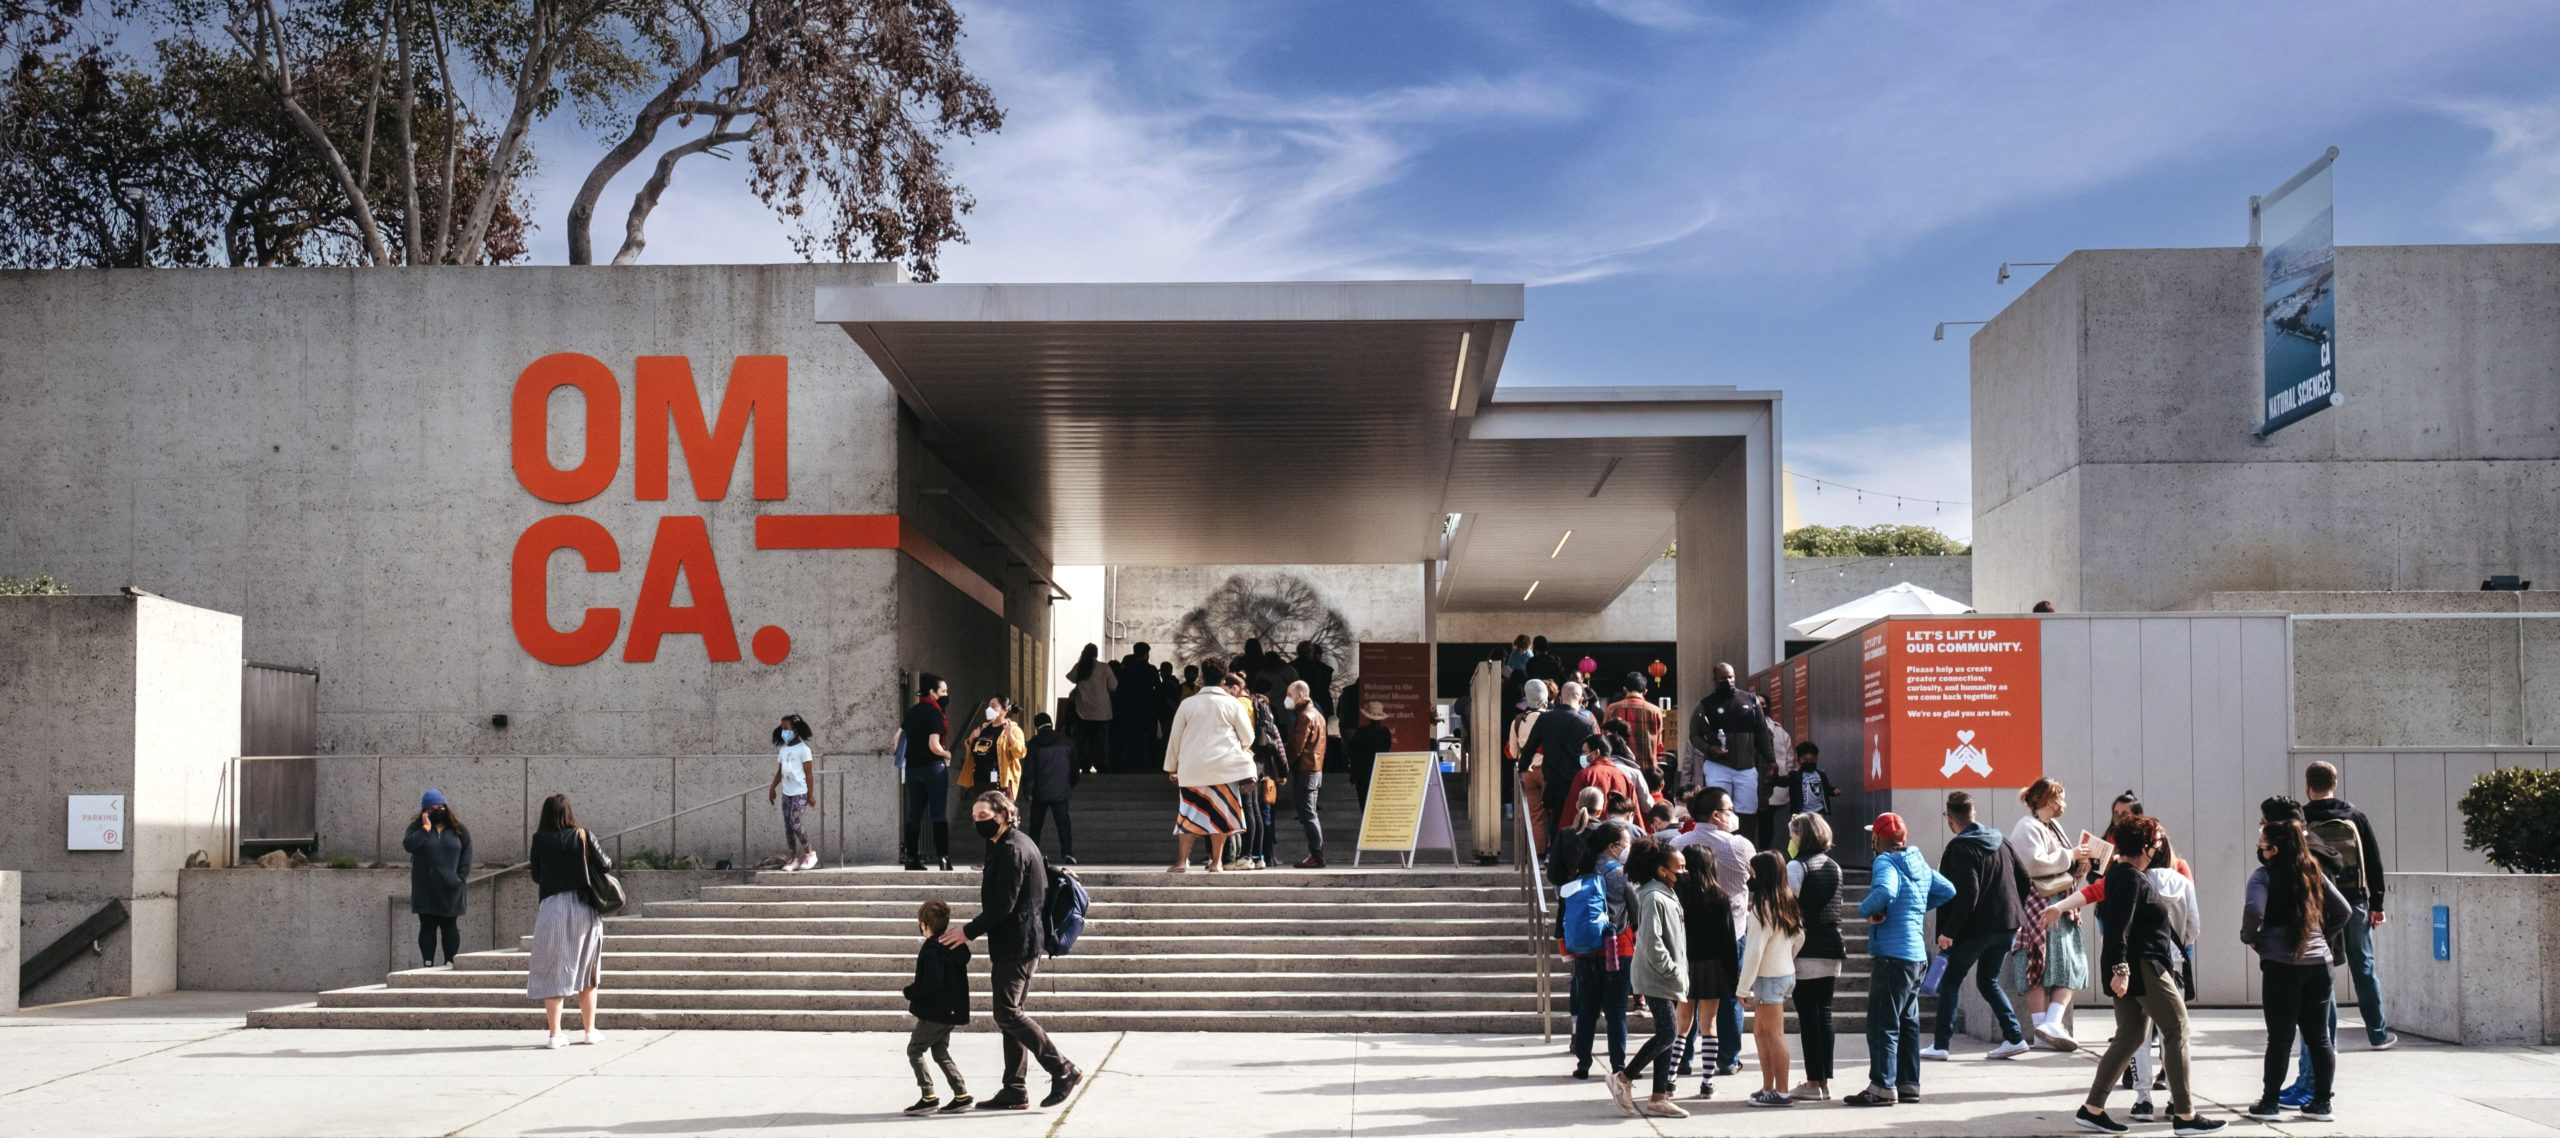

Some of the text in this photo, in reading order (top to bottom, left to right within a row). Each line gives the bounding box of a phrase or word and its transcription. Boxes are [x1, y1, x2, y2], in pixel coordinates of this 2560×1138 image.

[2321, 341, 2331, 367] CA
[2269, 369, 2331, 420] NATURAL SCIENCES
[512, 352, 788, 505] OM
[512, 514, 791, 667] CA.
[1906, 630, 1996, 641] LET'S LIFT UP
[1906, 642, 2022, 653] OUR COMMUNITY.
[1936, 666, 1953, 674] help
[1961, 684, 1997, 692] humanity
[1964, 693, 1998, 701] together.
[1943, 710, 1960, 718] glad
